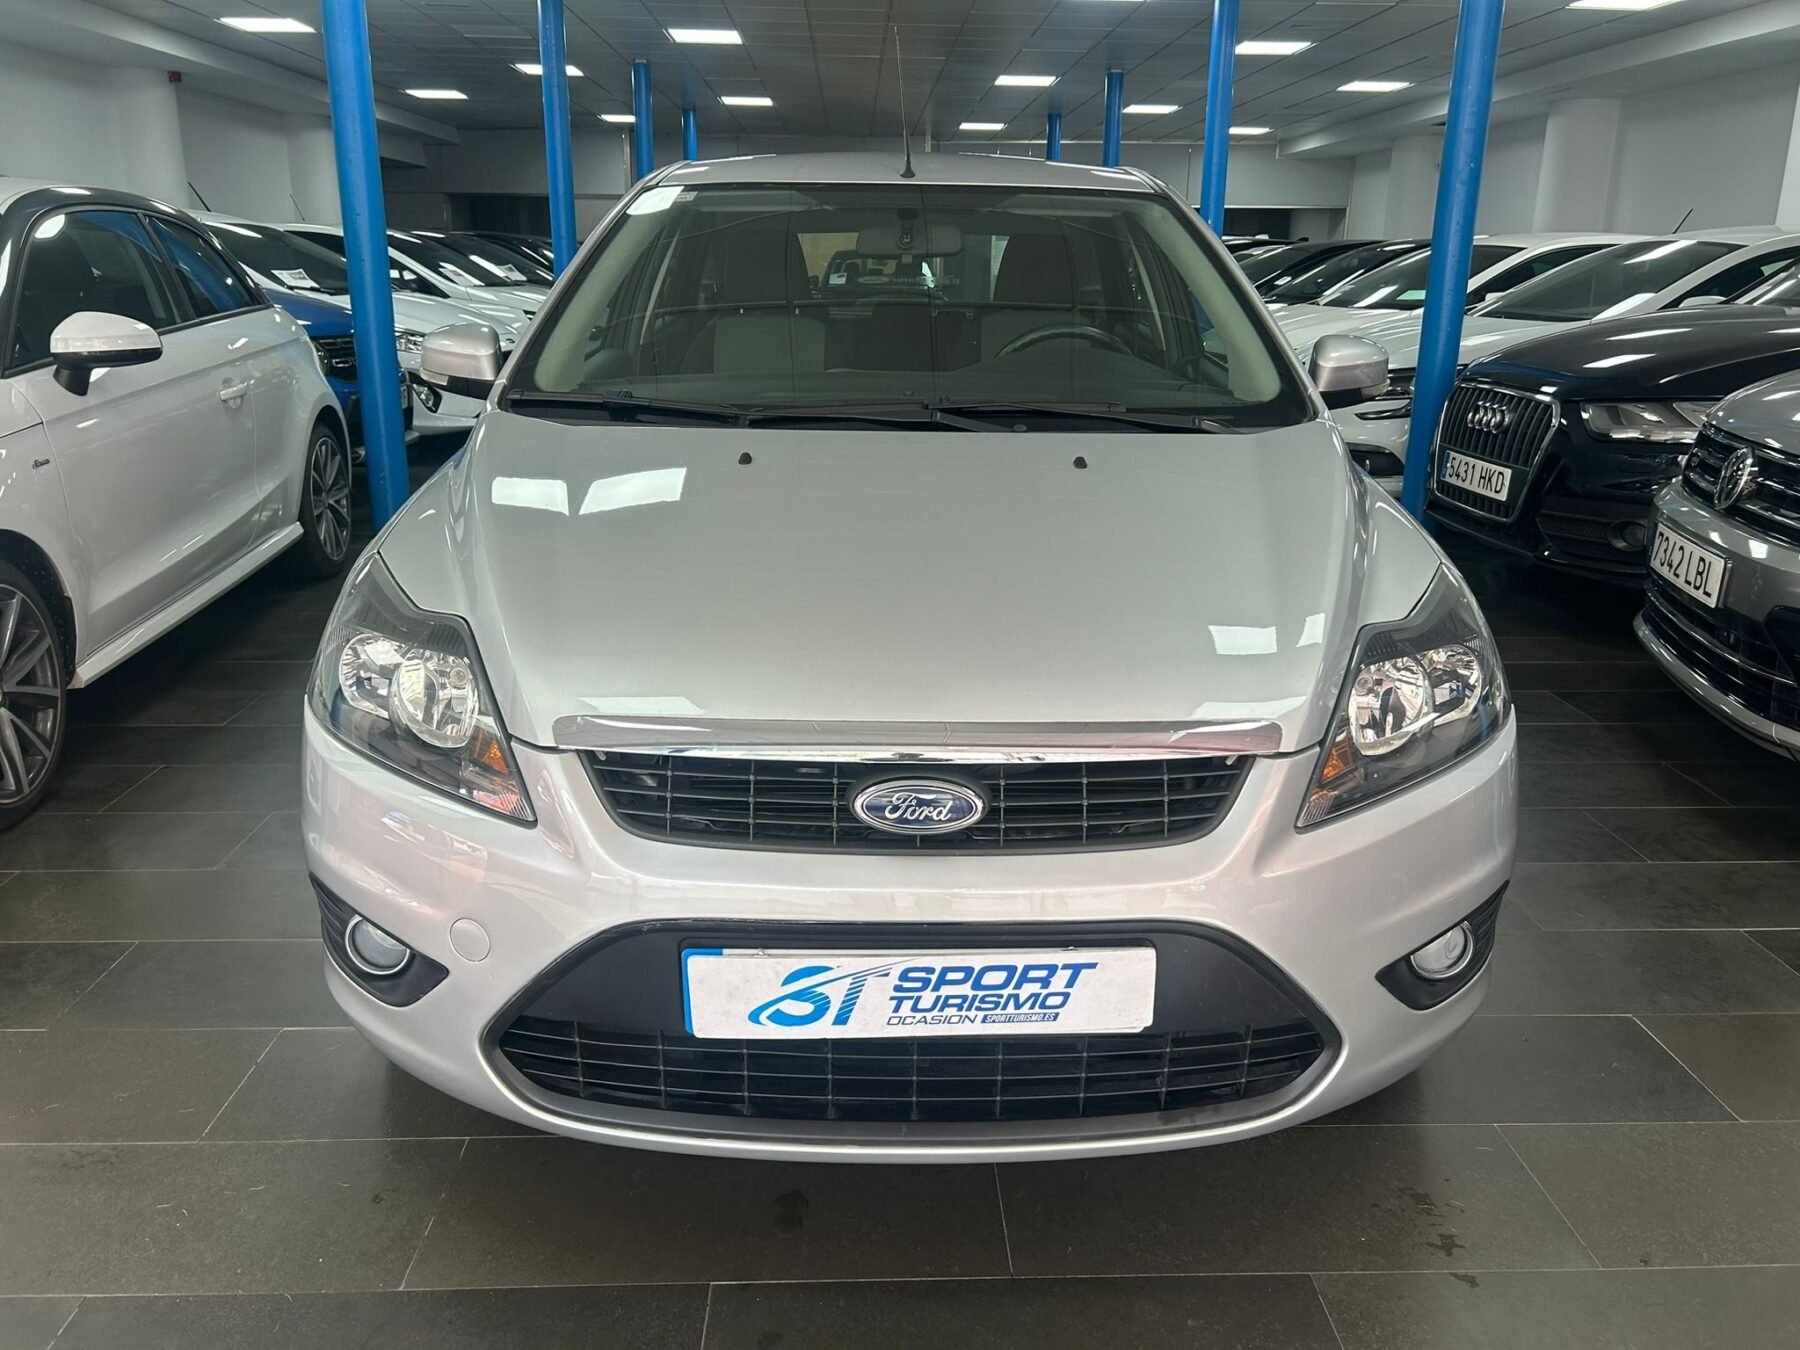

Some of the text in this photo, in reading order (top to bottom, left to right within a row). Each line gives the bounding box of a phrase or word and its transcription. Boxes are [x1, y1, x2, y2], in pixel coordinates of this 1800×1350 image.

[1448, 456, 1505, 494] 5431 HKD
[1653, 530, 1712, 598] 7342 LBL
[884, 791, 953, 821] Ford
[892, 962, 1099, 993] SPORT
[888, 991, 1071, 1013] TURISMO
[886, 1013, 1056, 1026] OCASION SPORTTURISMO.ES
